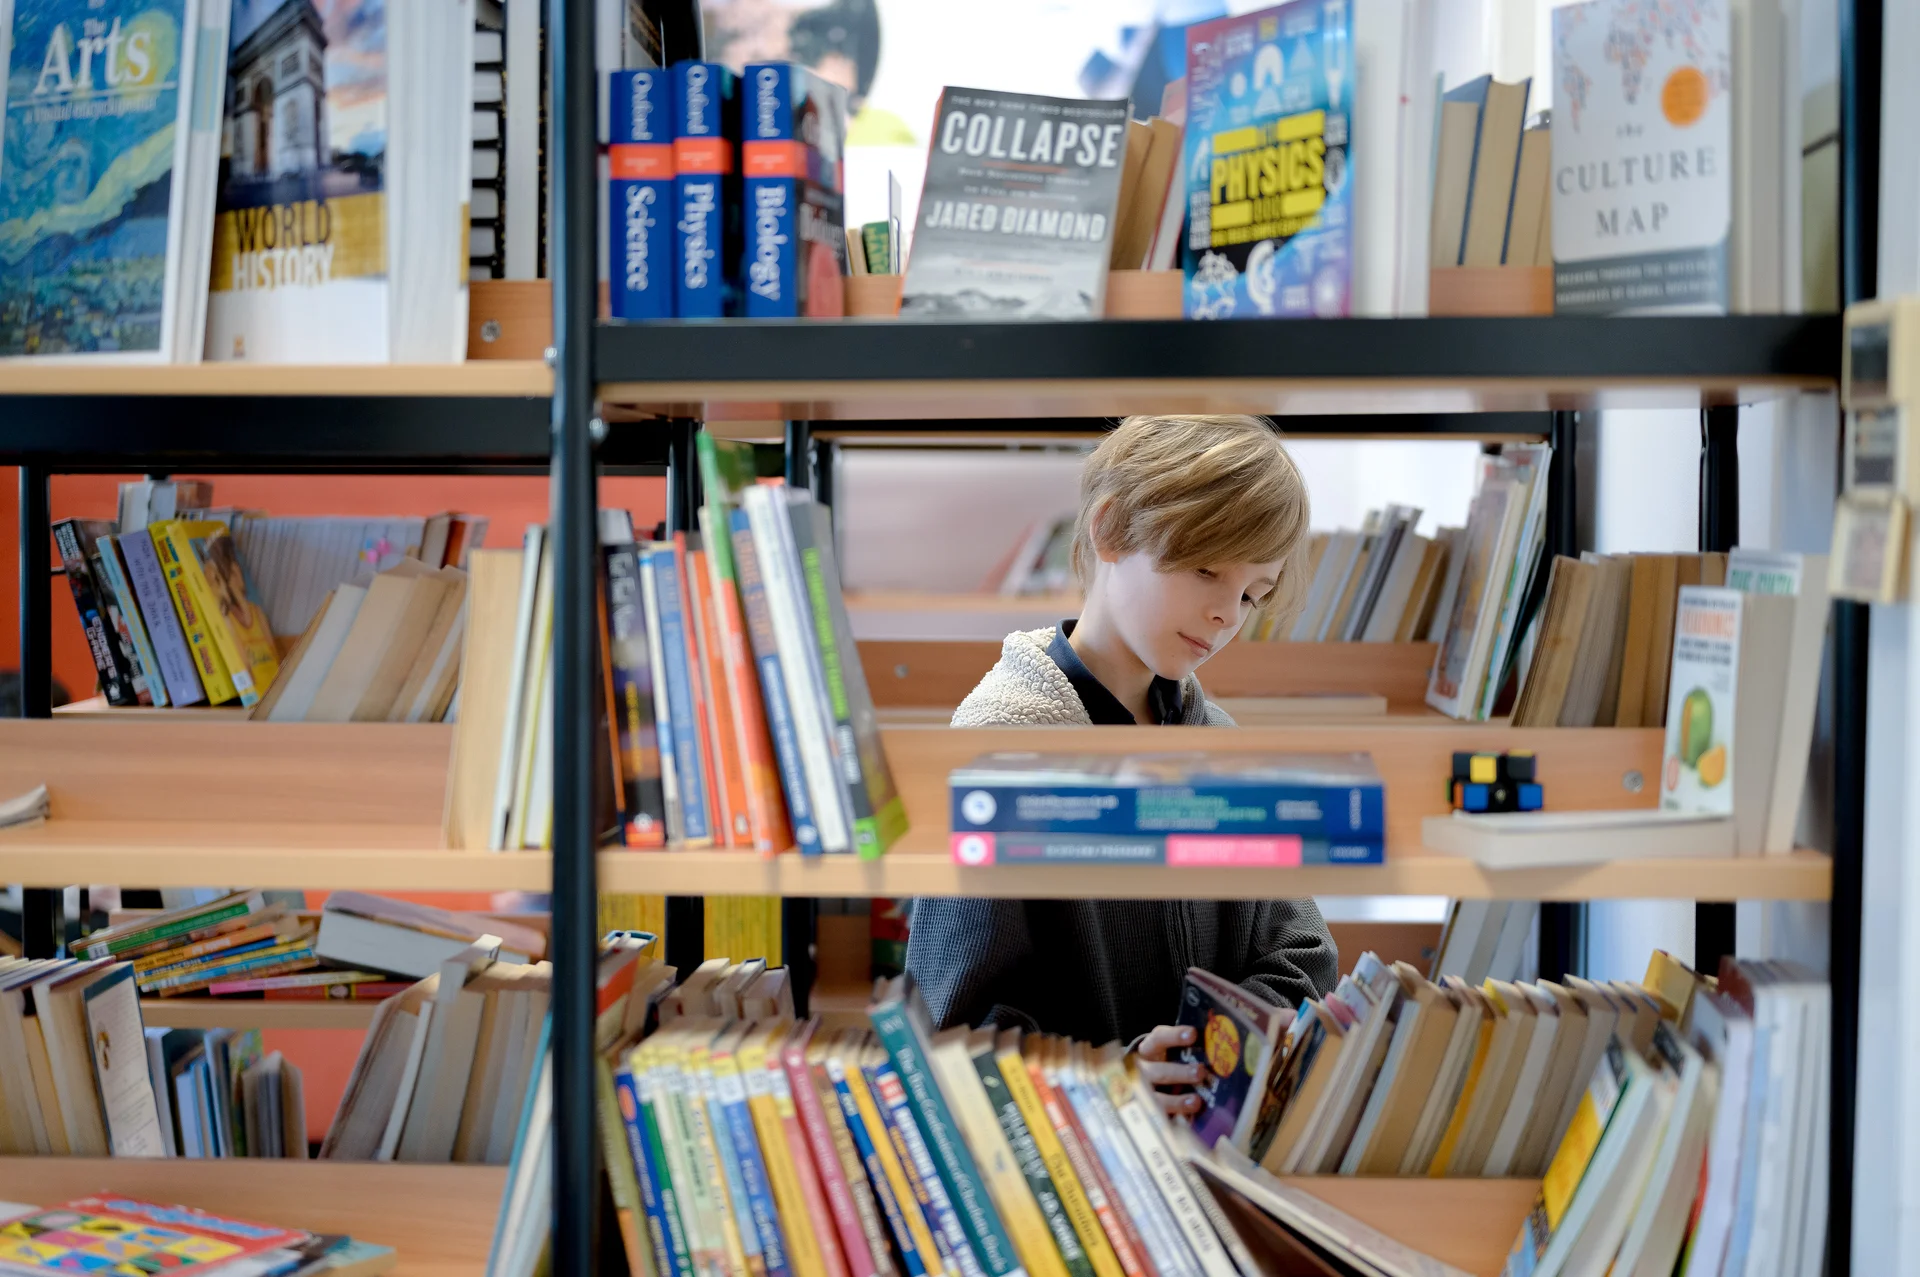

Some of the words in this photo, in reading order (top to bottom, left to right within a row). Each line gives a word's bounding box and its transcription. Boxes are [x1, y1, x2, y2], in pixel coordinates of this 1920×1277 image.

[33, 16, 151, 94] Arts
[940, 110, 1123, 168] COLLAPSE
[1211, 136, 1326, 204] PHYSICS
[1556, 145, 1717, 196] CULTURE
[235, 201, 331, 252] WORLD
[626, 185, 656, 292] Science
[678, 182, 715, 289] Physics
[750, 185, 788, 300] Biology
[925, 200, 998, 232] JARED
[1001, 205, 1106, 241] DIAMOND
[1596, 202, 1669, 237] MAP
[232, 244, 334, 290] HISTORY
[86, 626, 107, 671] GAME
